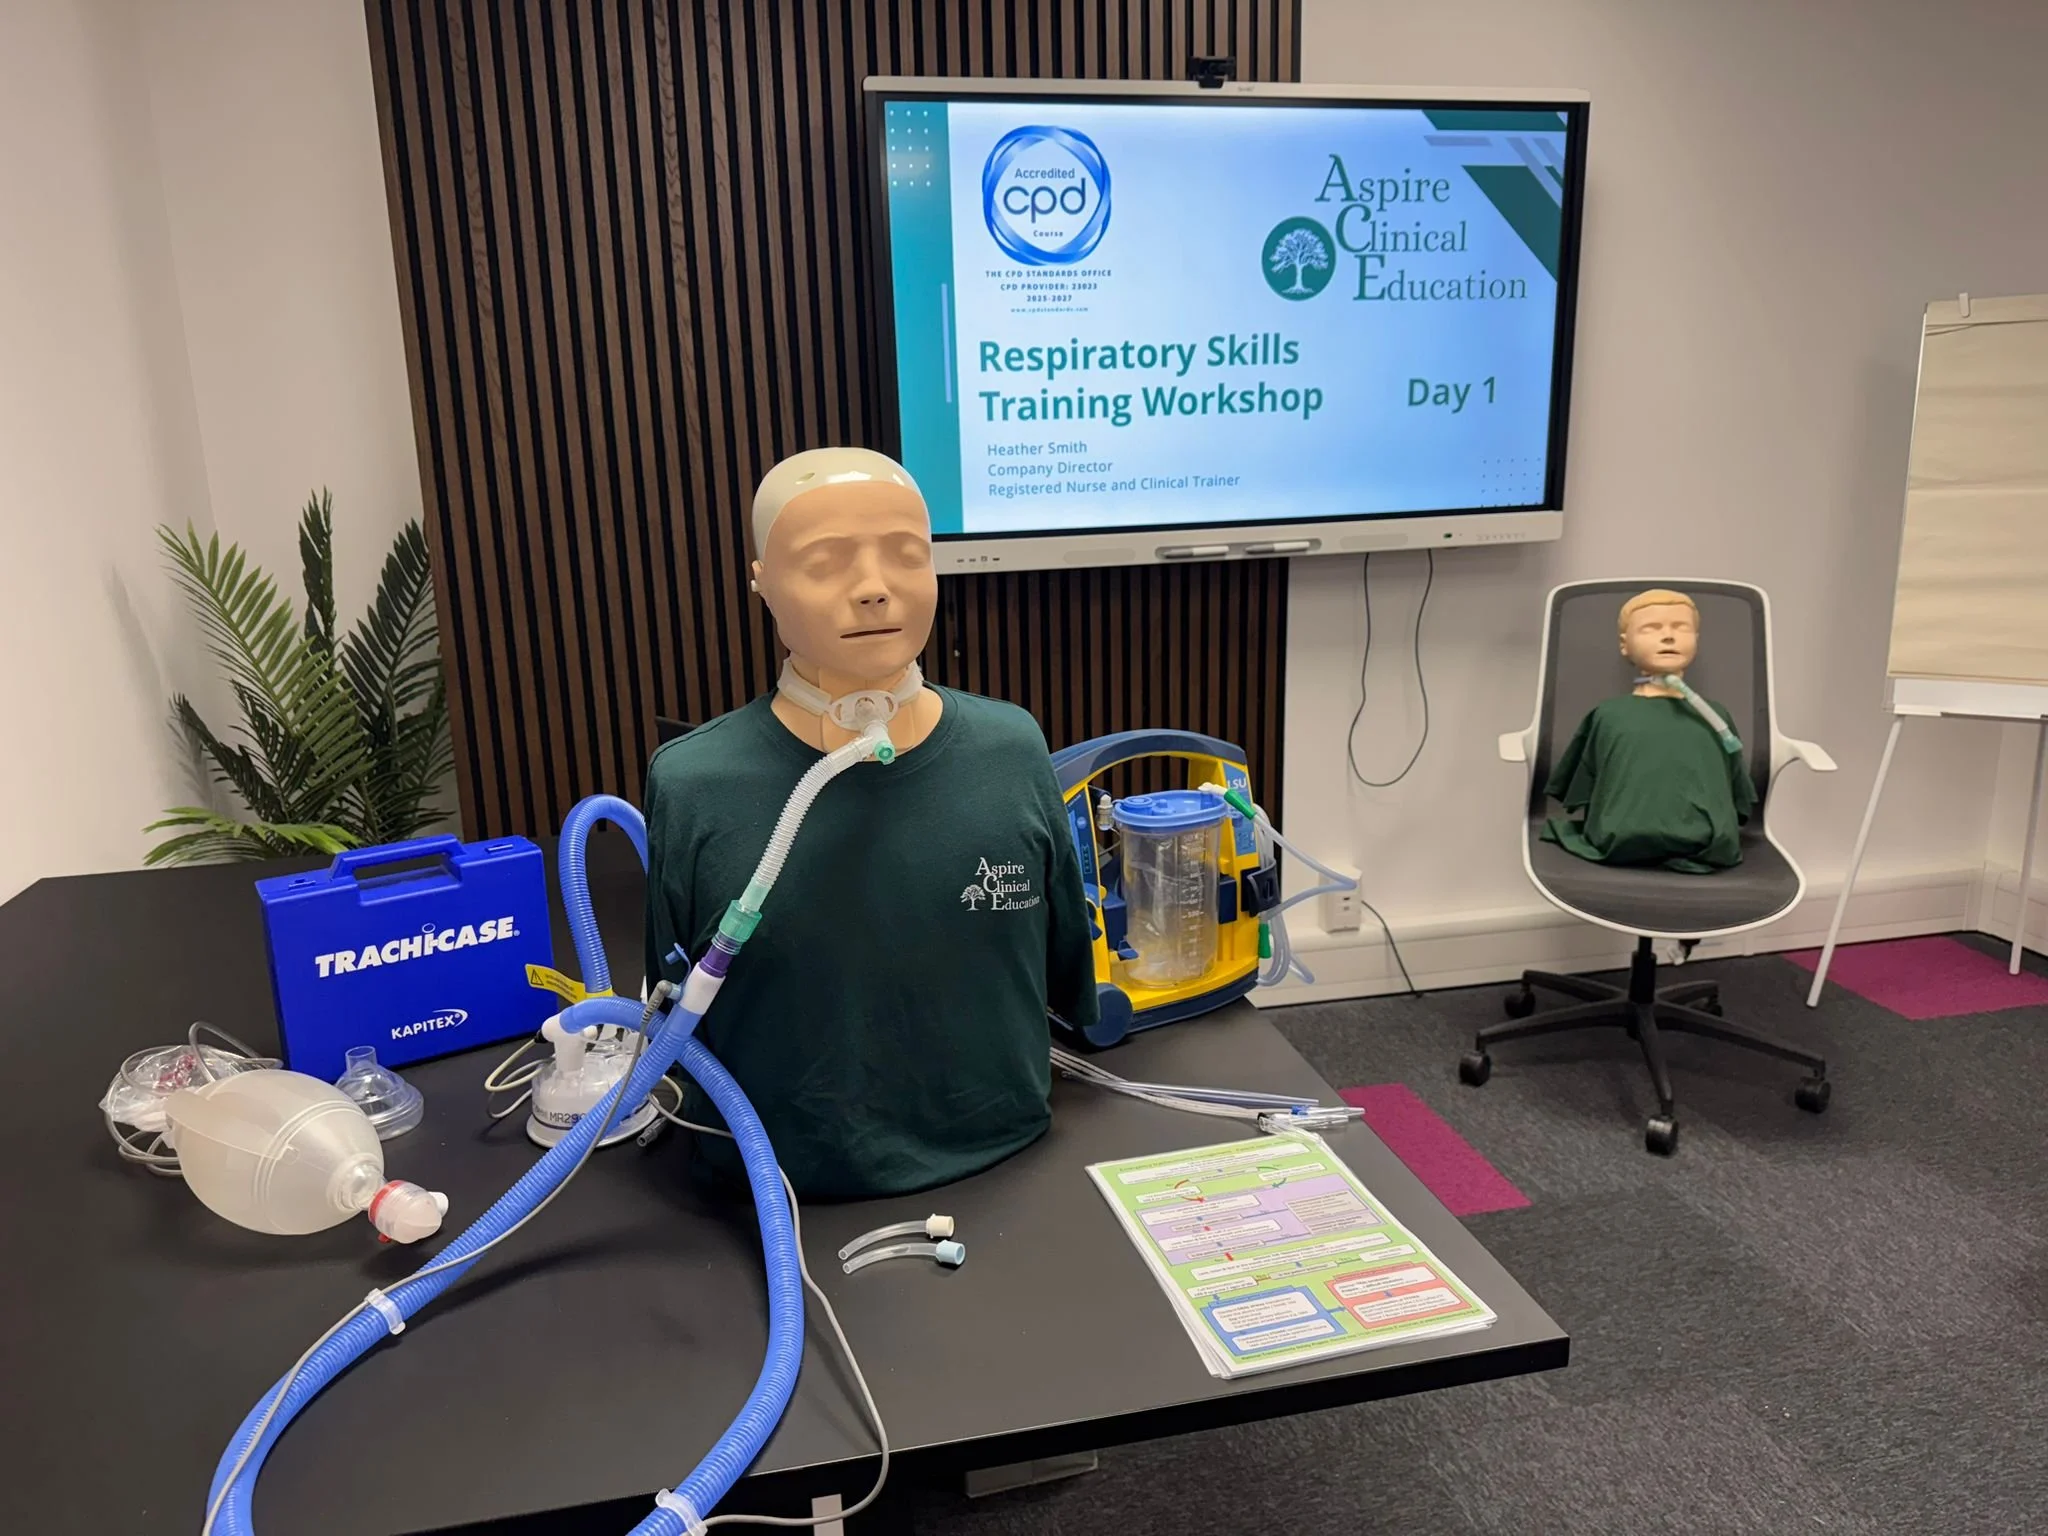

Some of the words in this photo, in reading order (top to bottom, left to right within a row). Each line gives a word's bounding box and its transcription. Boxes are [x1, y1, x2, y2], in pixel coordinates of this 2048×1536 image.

[1014, 167, 1076, 179] Accredited
[1314, 153, 1451, 213] Aspire
[1003, 177, 1086, 224] cpd
[1033, 229, 1064, 238] Course
[1335, 203, 1468, 253] Clinical
[985, 270, 1002, 278] THE
[1005, 270, 1023, 278] CPD
[1026, 269, 1078, 278] STANDARDS
[1081, 269, 1112, 278] OFFICE
[1352, 253, 1528, 301] Education
[1000, 283, 1018, 291] CPD
[979, 338, 1197, 380] Respiratory
[1206, 333, 1300, 367] Skills
[978, 388, 1132, 427] Training
[1142, 381, 1324, 420] Workshop
[1408, 378, 1472, 414] Day
[1482, 376, 1495, 404] 1
[987, 443, 1044, 456] Heather
[1047, 441, 1088, 454] Smith
[987, 464, 1053, 478] Company
[1057, 461, 1113, 474] Director
[988, 481, 1062, 499] Registered
[1066, 481, 1107, 493] Nurse
[1111, 479, 1136, 491] and
[1140, 476, 1189, 490] Clinical
[1192, 475, 1241, 488] Trainer
[975, 856, 1025, 878] Aspire
[982, 873, 1031, 893] Clinical
[991, 892, 1041, 911] Education
